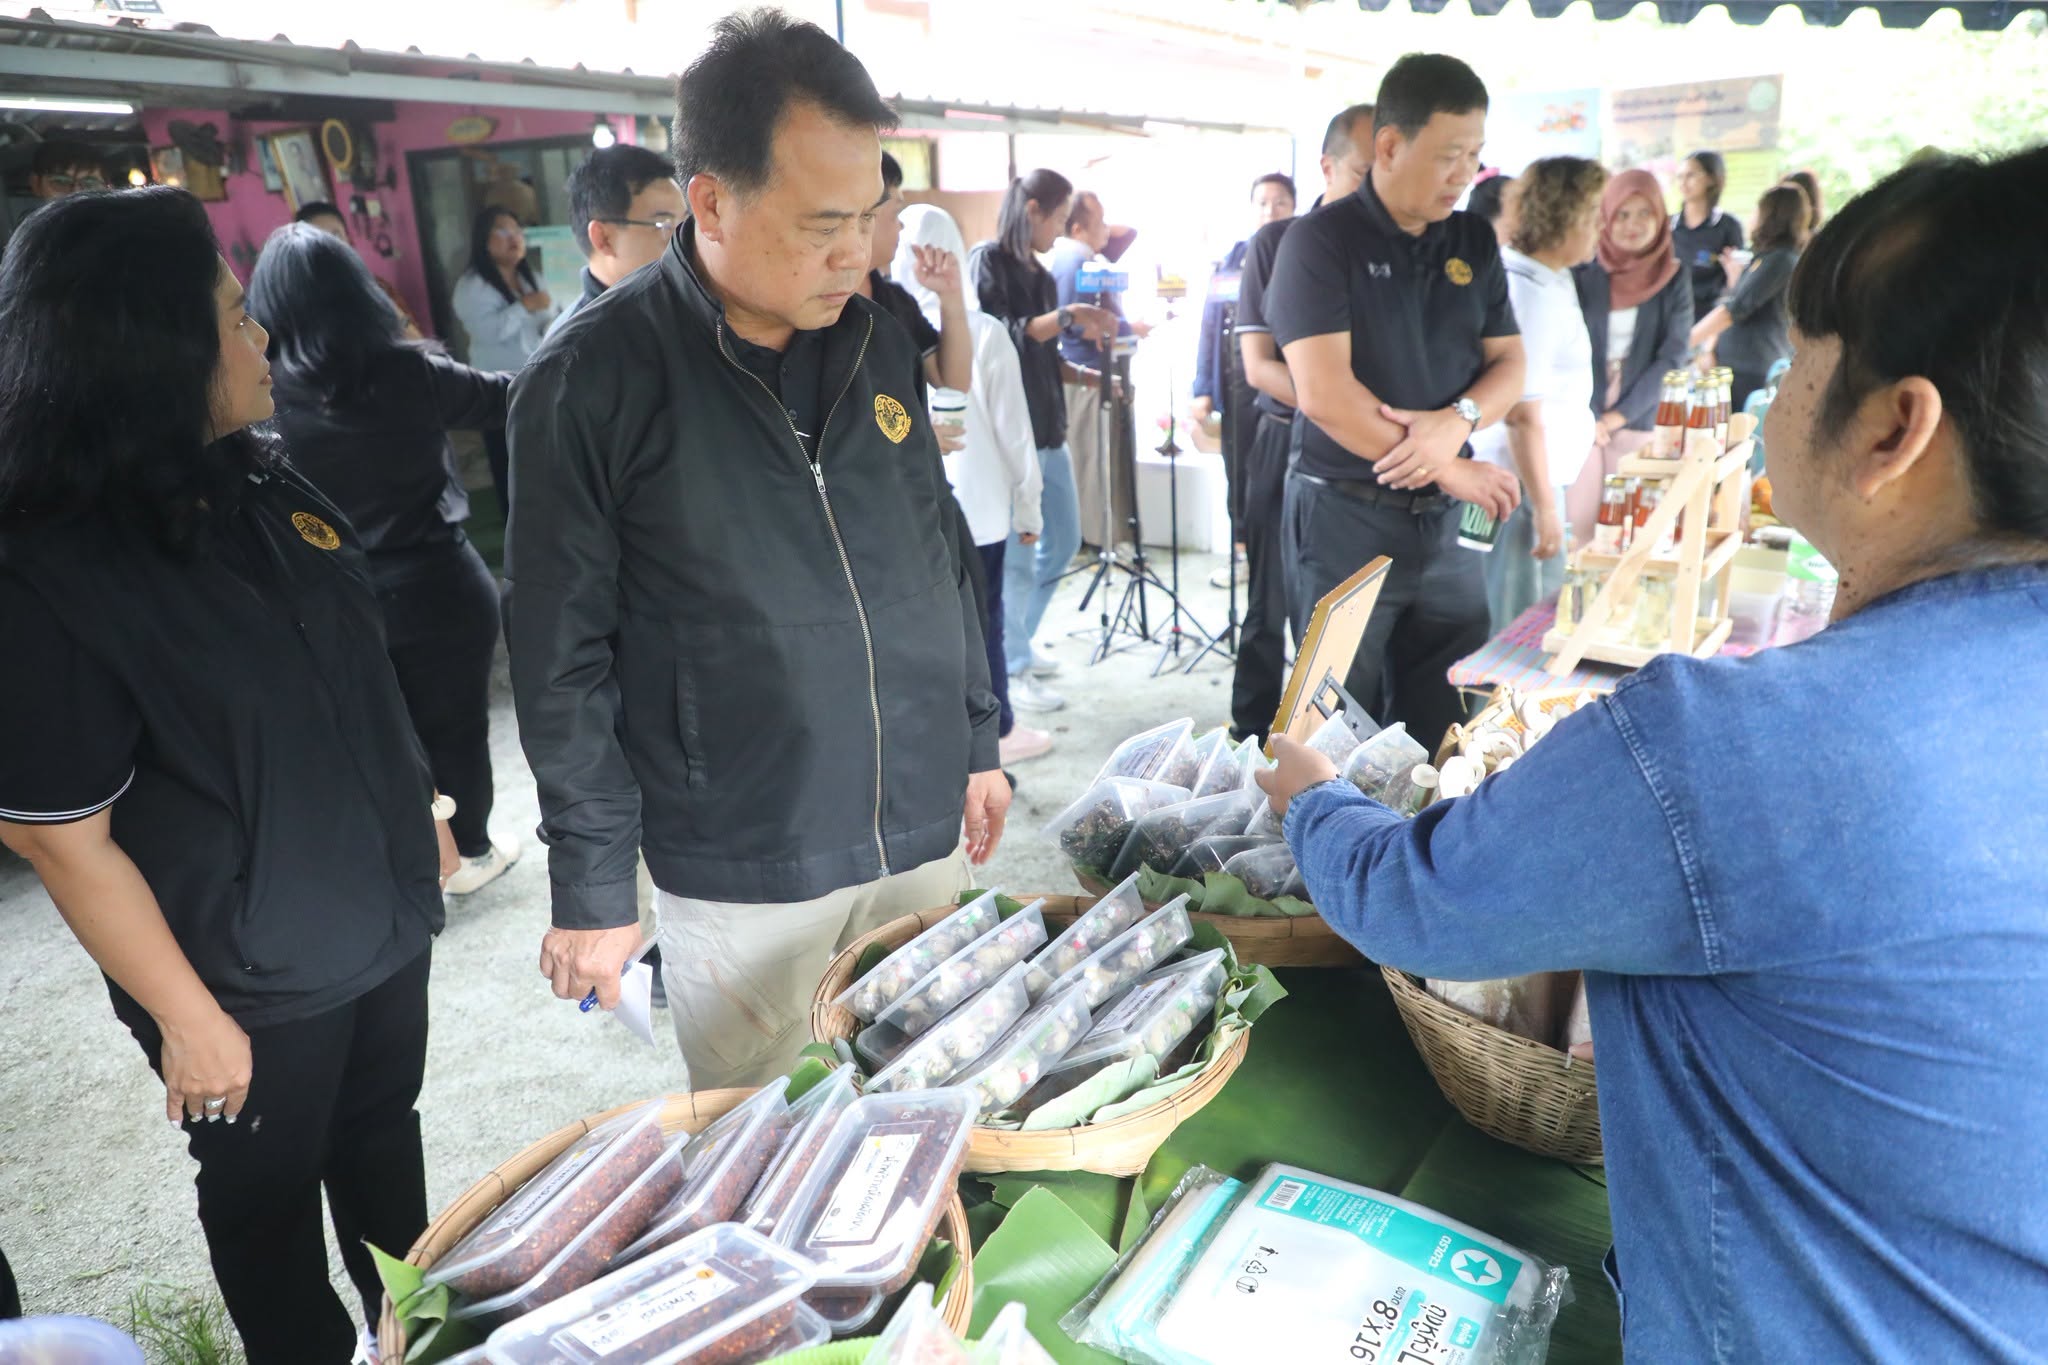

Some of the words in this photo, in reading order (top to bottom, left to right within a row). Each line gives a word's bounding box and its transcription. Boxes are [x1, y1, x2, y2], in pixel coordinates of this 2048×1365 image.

[1428, 1235, 1451, 1268] ตราดาว
[1391, 1286, 1406, 1306] ขนาด
[1410, 1302, 1448, 1354] ถุงหูหิ้ว
